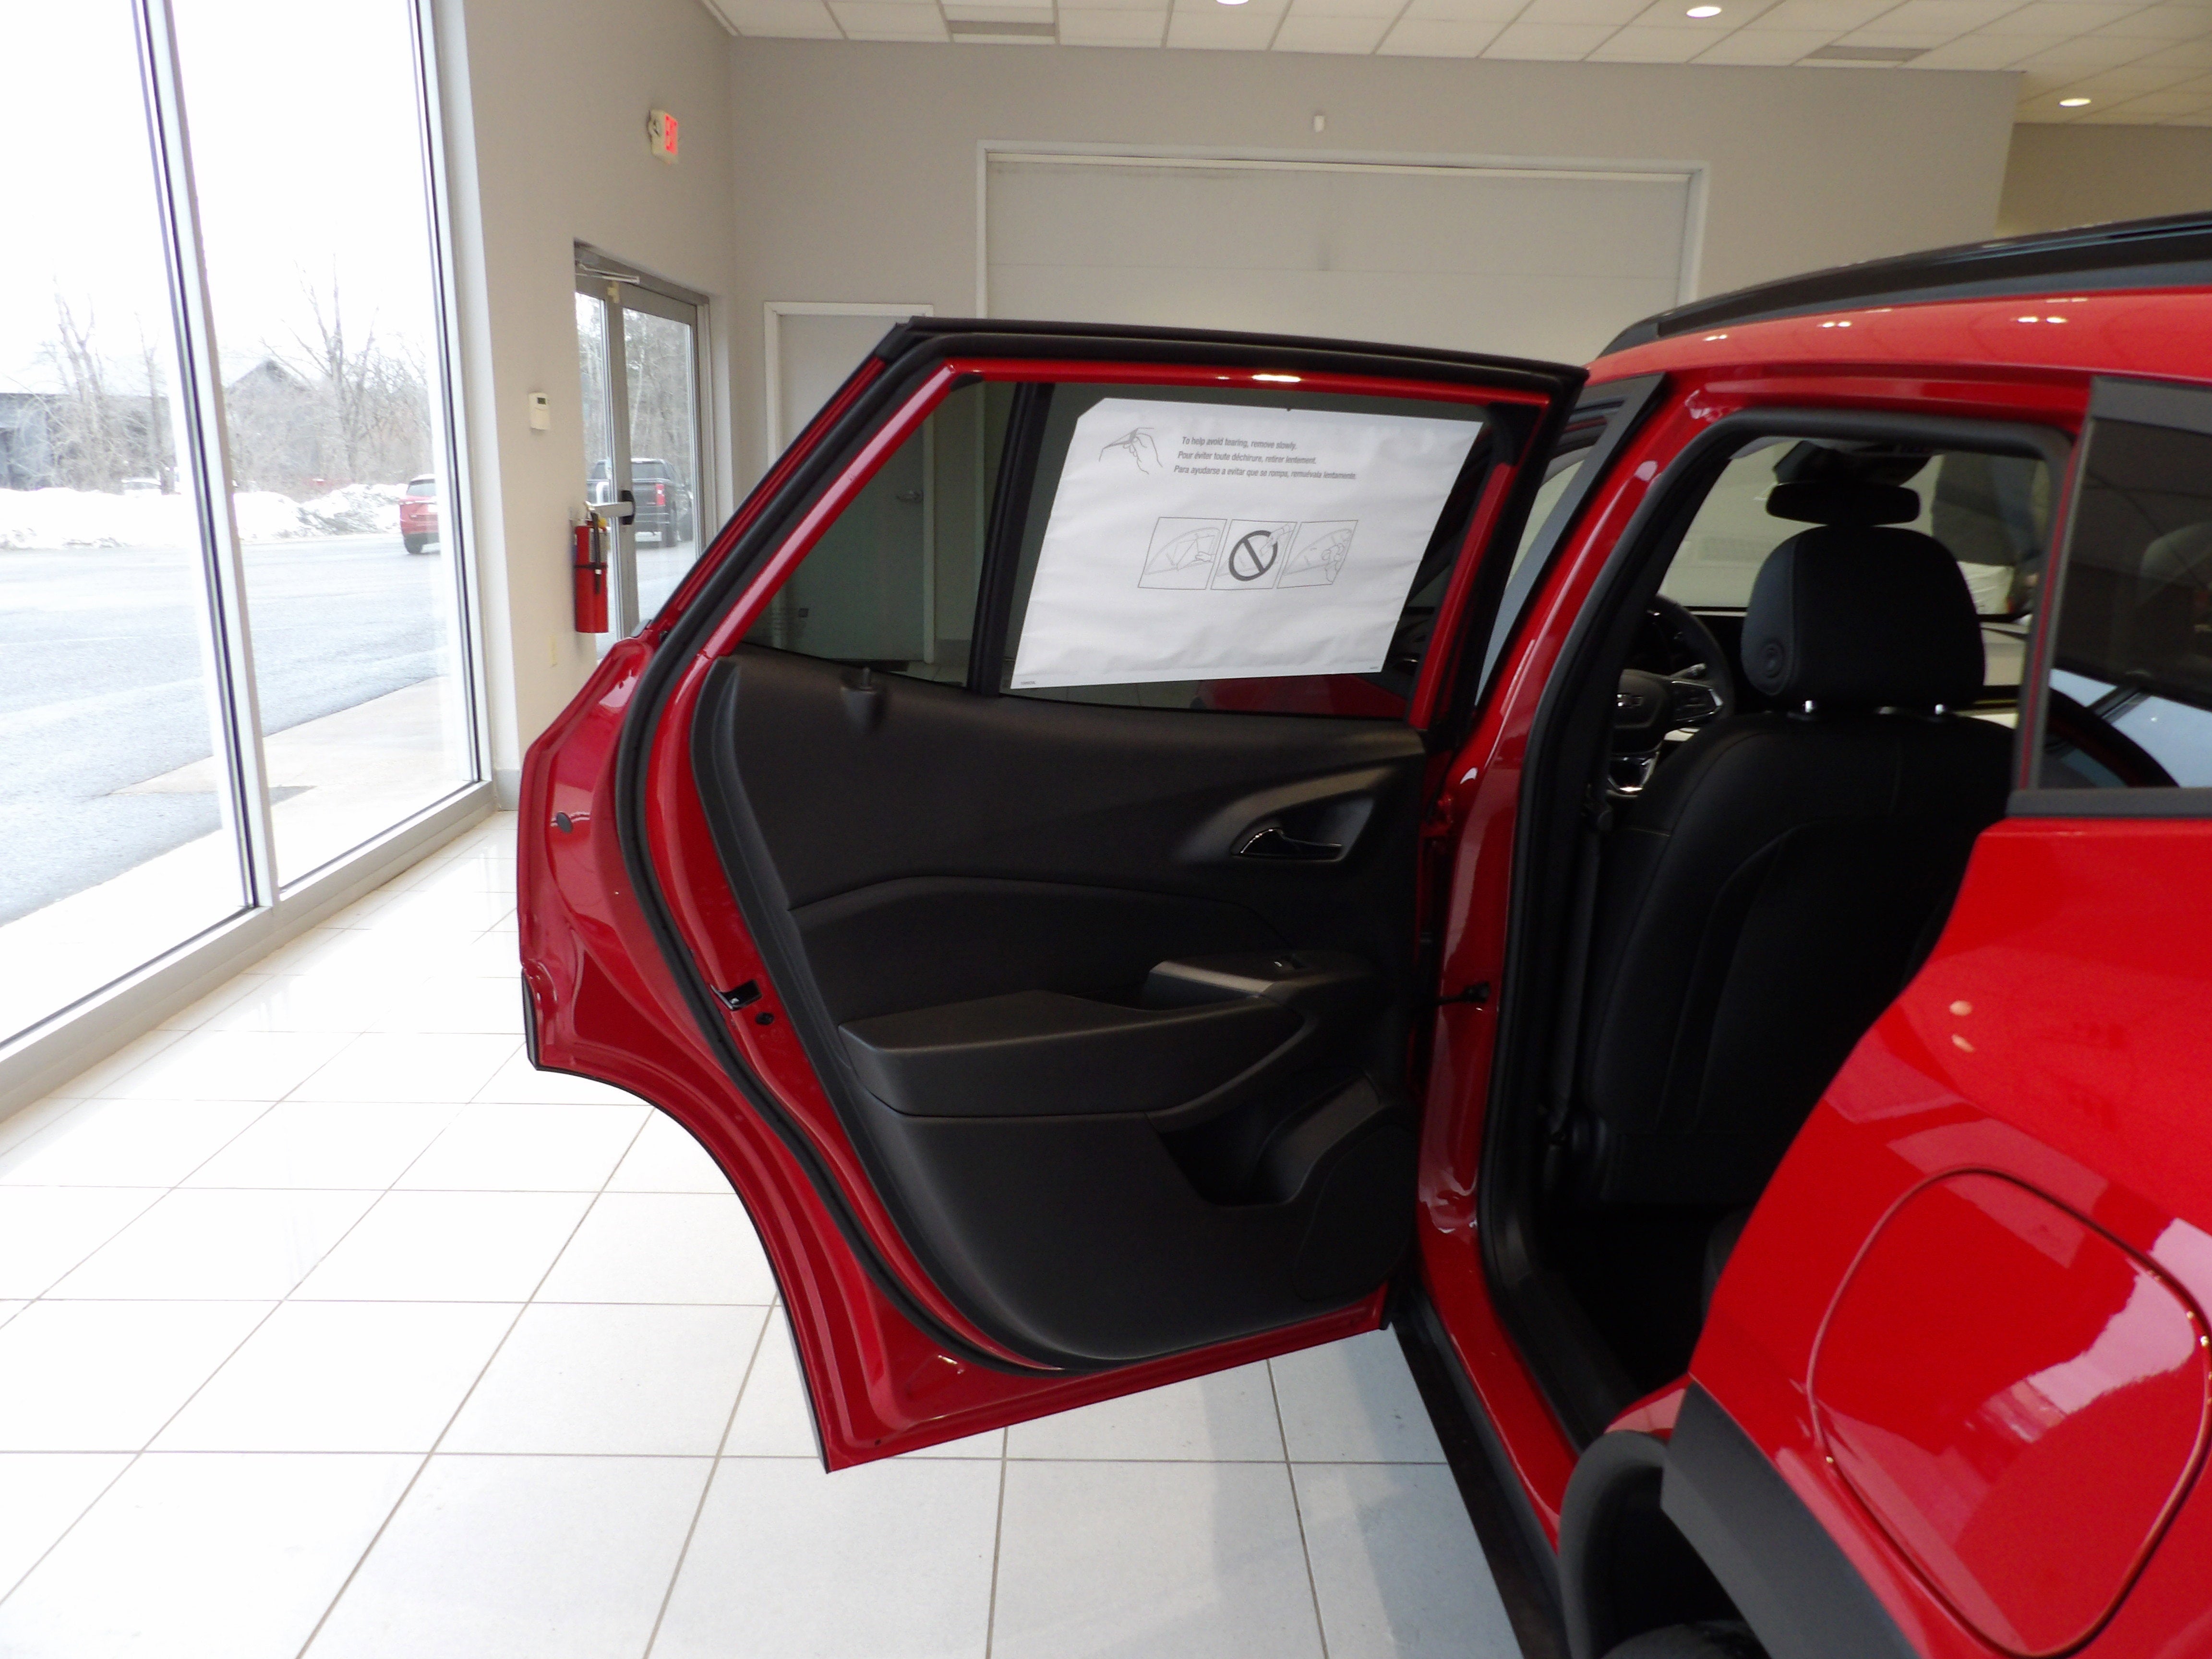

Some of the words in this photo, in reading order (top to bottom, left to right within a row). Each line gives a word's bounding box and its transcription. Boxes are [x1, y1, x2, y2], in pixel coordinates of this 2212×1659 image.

[1182, 436, 1190, 445] To
[1191, 437, 1205, 446] help
[1206, 437, 1224, 445] avoid
[1225, 438, 1248, 448] tearing,
[1276, 442, 1297, 451] slowly.
[1178, 451, 1194, 459] Pour
[1194, 451, 1212, 459] éviter
[1214, 452, 1230, 460] toute
[1232, 453, 1263, 463] déchirure,
[1286, 456, 1316, 464] lentement.
[1174, 465, 1189, 473] Para
[1190, 467, 1220, 475] ayudarse
